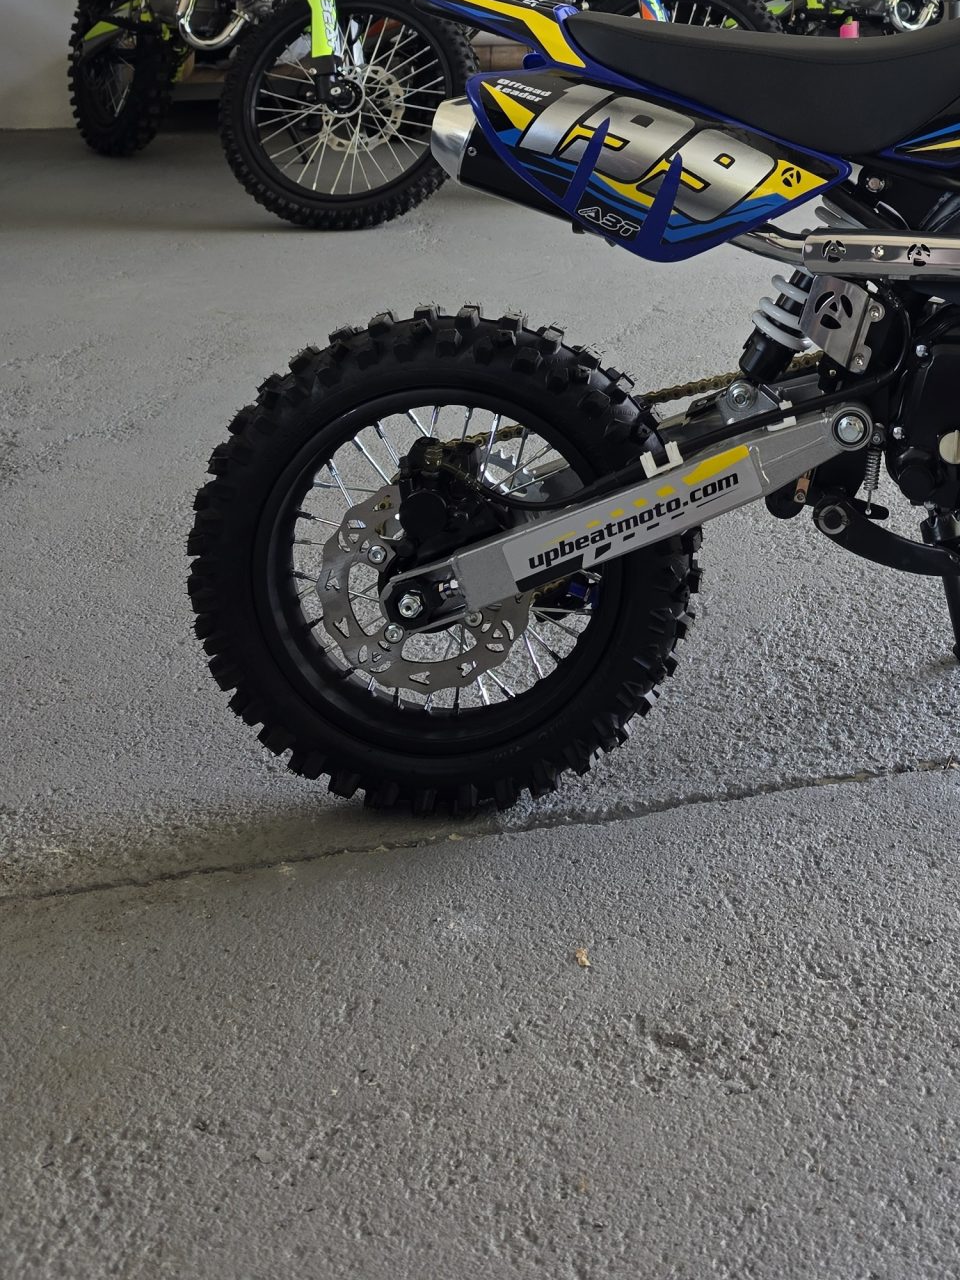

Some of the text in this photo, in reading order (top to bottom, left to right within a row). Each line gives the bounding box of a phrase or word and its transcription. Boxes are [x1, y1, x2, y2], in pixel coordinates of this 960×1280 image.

[494, 84, 543, 103] Leader
[496, 78, 553, 97] Offroad
[518, 83, 781, 223] 199
[527, 472, 740, 571] upbeatmoto.com
